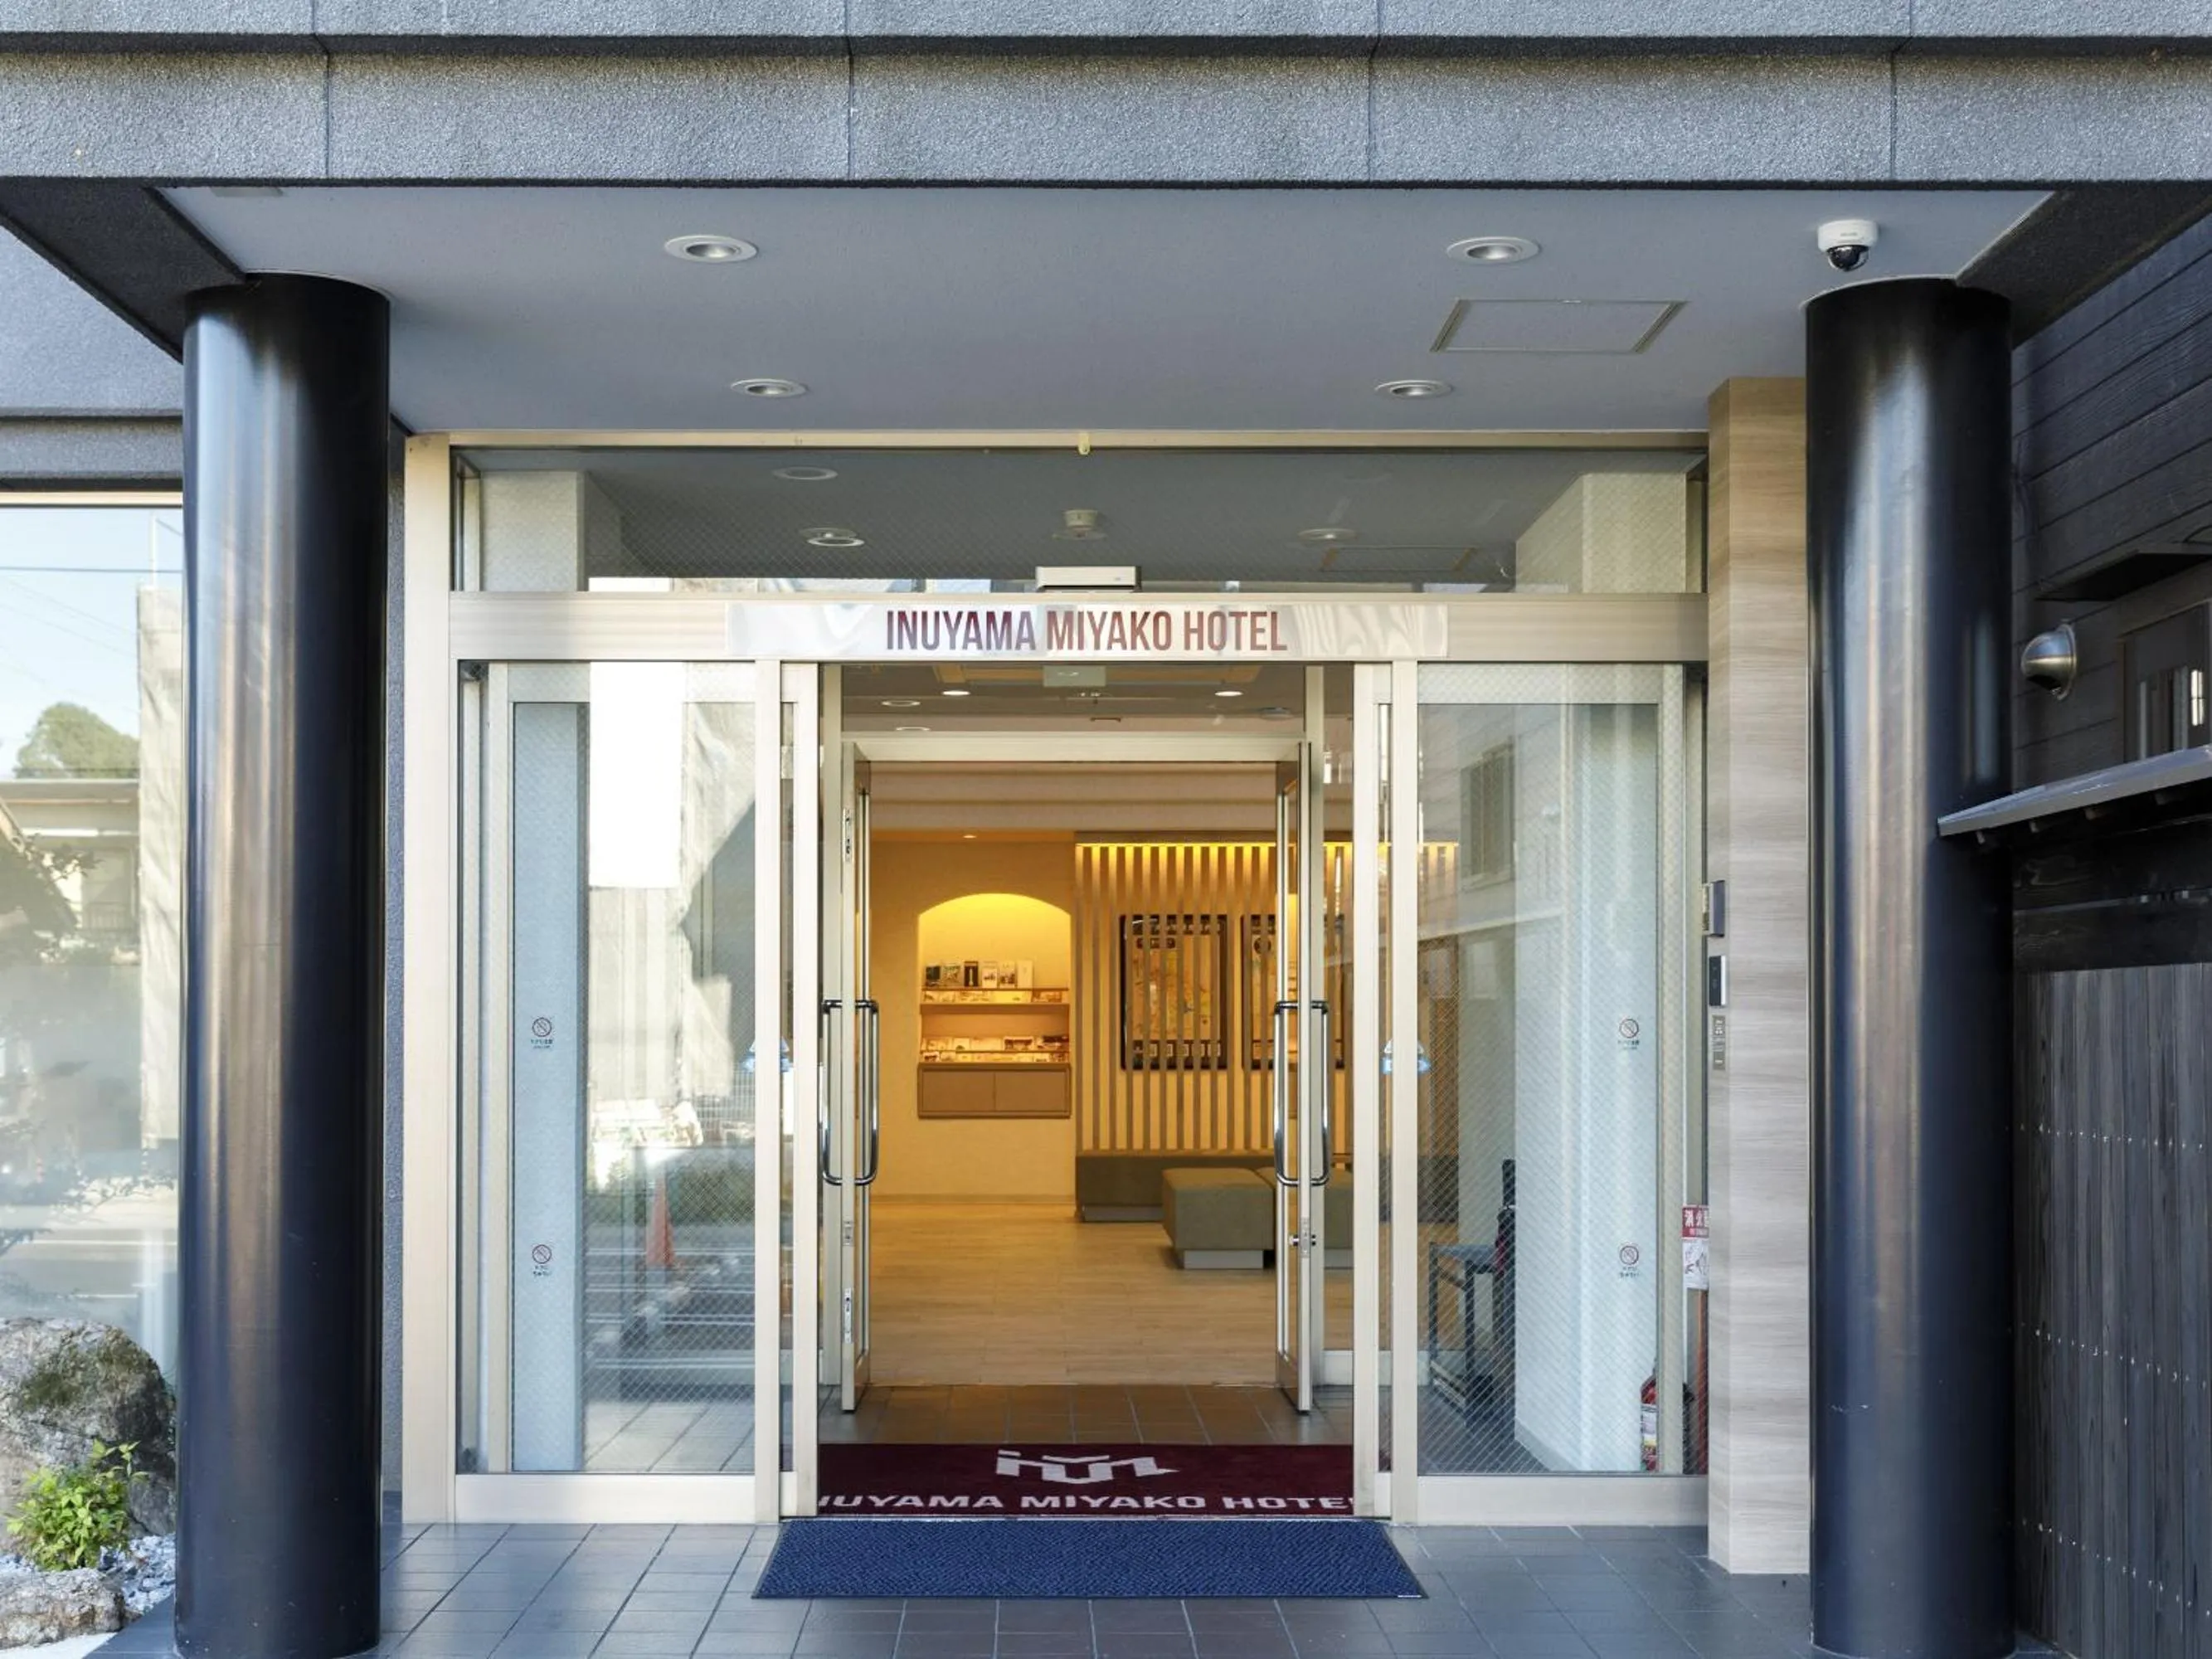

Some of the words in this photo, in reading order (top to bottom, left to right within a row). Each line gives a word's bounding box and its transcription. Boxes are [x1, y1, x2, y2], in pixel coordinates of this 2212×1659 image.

[887, 610, 1036, 651] INUYAMA
[1046, 610, 1172, 651] MIYAKO
[1184, 610, 1288, 651] HOTEL
[1021, 1496, 1206, 1509] MIYAKO
[1222, 1496, 1354, 1509] HOTE
